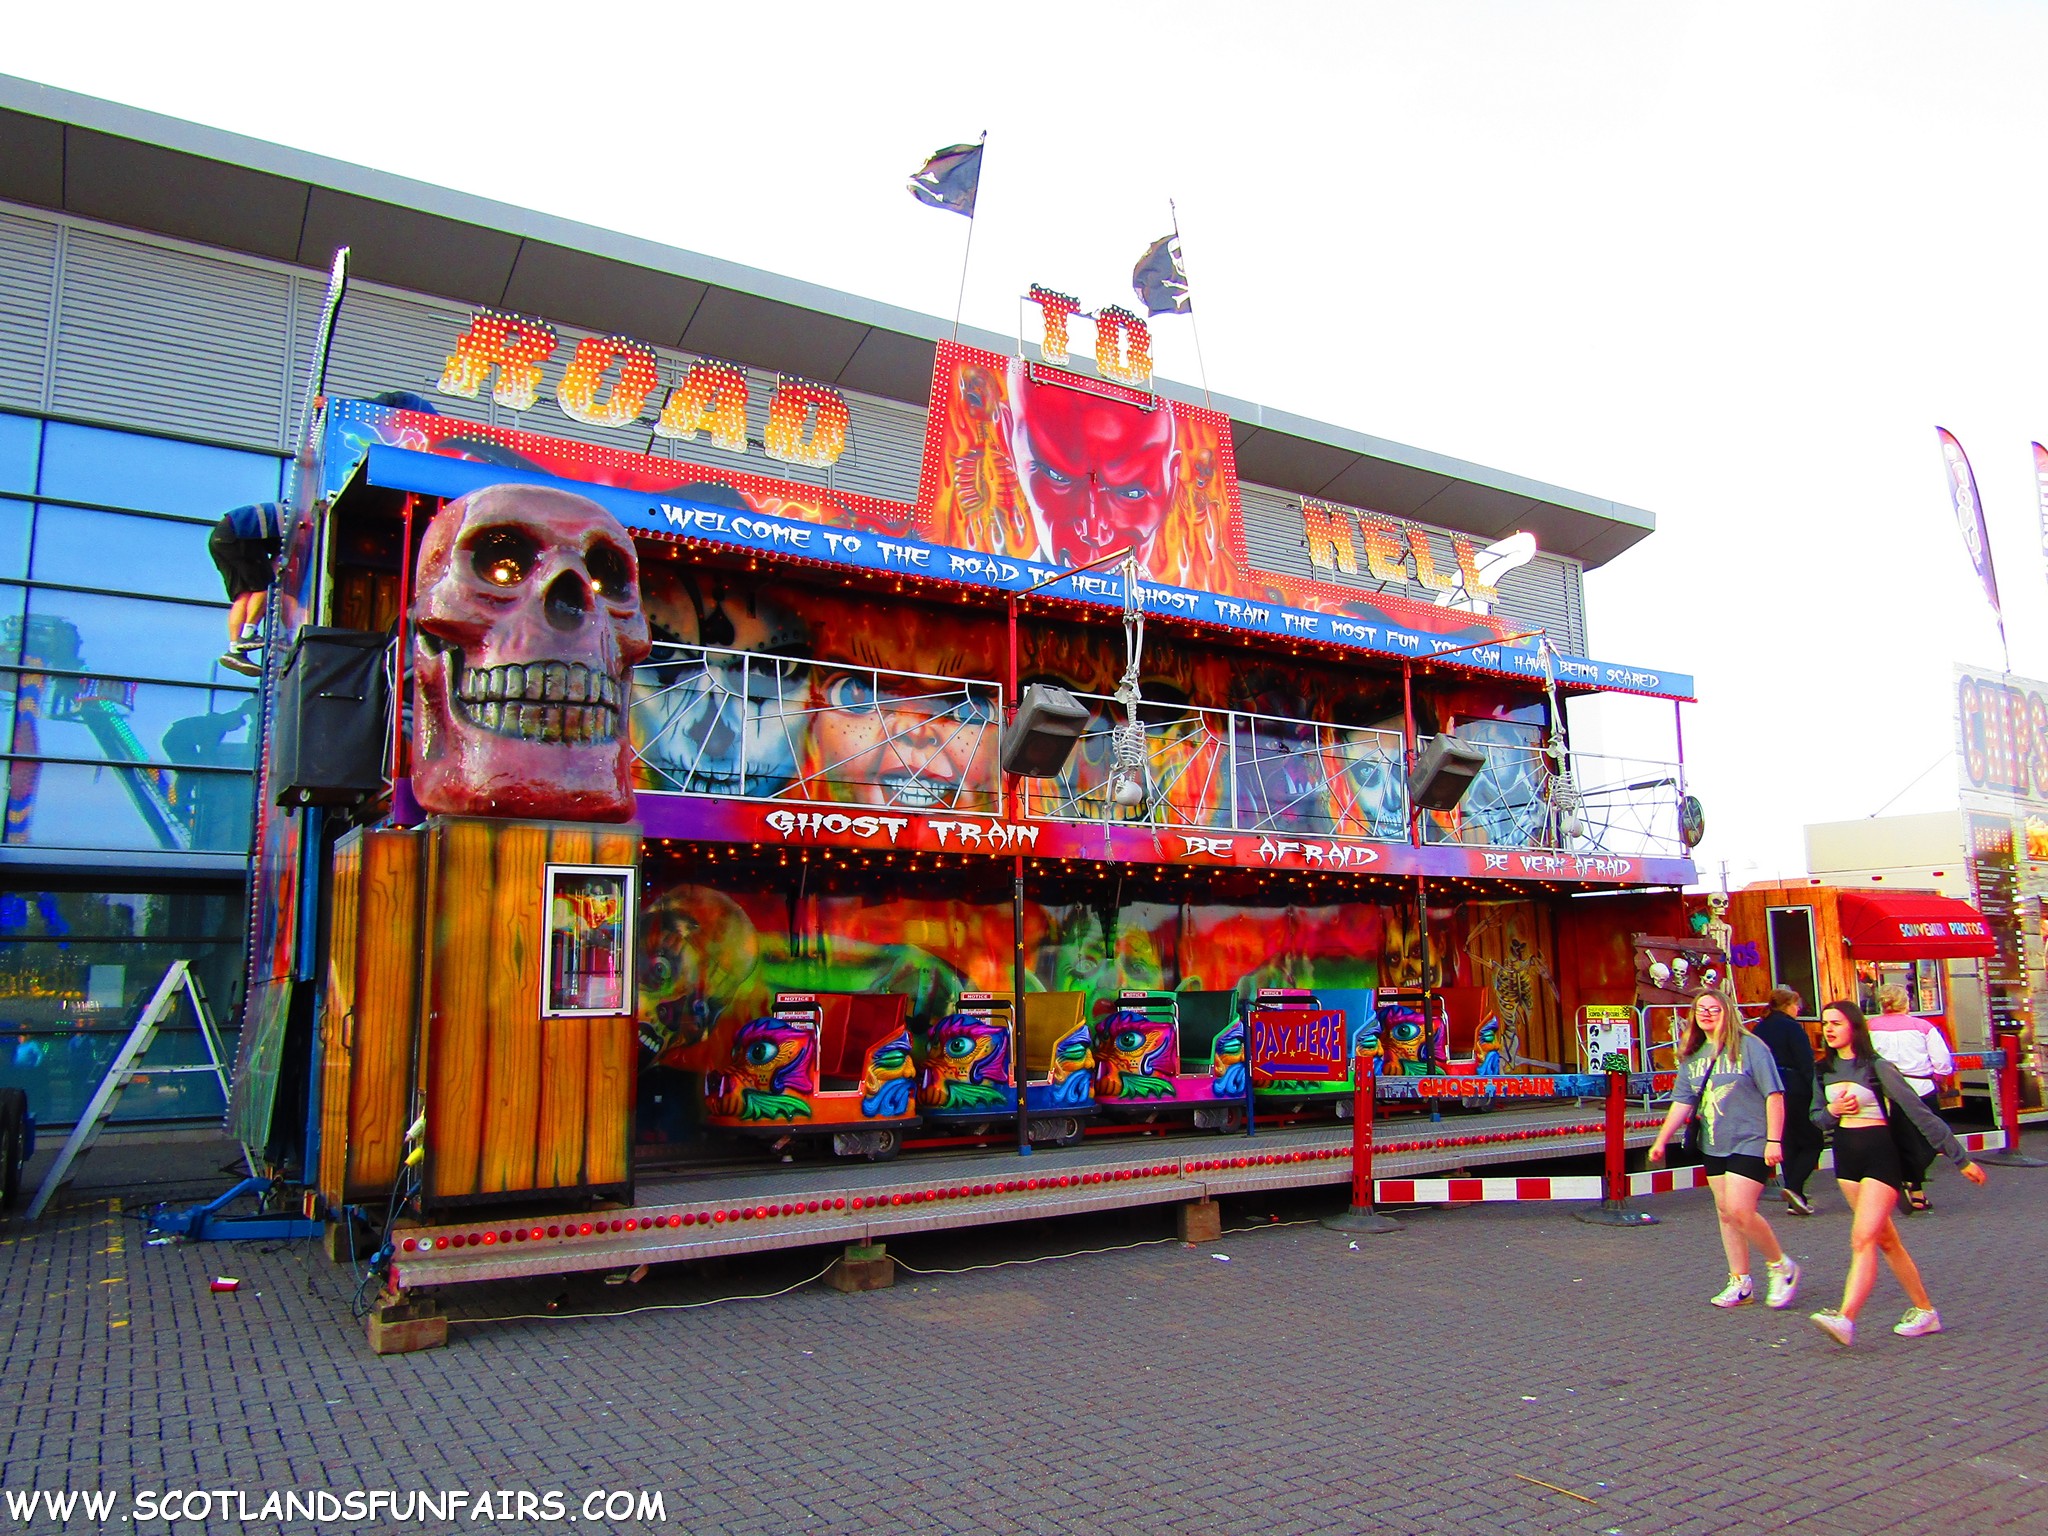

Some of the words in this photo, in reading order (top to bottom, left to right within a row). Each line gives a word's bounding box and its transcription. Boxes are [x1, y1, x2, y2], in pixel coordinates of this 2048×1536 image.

[437, 306, 850, 468] ROAD
[1029, 282, 1152, 387] TO
[1300, 495, 1499, 604] HELL
[660, 503, 811, 547] WELCOME
[823, 532, 862, 557] TO
[877, 540, 931, 568] THE
[948, 552, 1020, 584] ROAD
[1027, 567, 1059, 588] TO
[1071, 575, 1122, 601] HELL
[1133, 586, 1199, 615] GHOST
[1214, 599, 1270, 627] TRAIN
[1281, 612, 1319, 633] THE
[1330, 620, 1377, 645] MOST
[1386, 629, 1420, 651] FUN
[1430, 639, 1462, 657] YOU
[1472, 645, 1501, 666] CAN
[1557, 658, 1599, 681] BEING
[1606, 668, 1660, 689] SCARED
[765, 810, 909, 843] GHOST
[928, 817, 1040, 850] TRAIN
[1177, 835, 1234, 858] BE
[1252, 835, 1379, 869] AFRAID
[1481, 852, 1509, 871] BE
[1519, 855, 1566, 876] VERY
[1573, 853, 1632, 877] AFRAID
[1899, 922, 1946, 937] SOUVENIR
[1948, 922, 1985, 935] PHOTOS
[1255, 1021, 1291, 1062] PAY
[1296, 1013, 1341, 1062] HERE
[1418, 1078, 1487, 1097] GHOST
[1492, 1077, 1554, 1096] TRAIN
